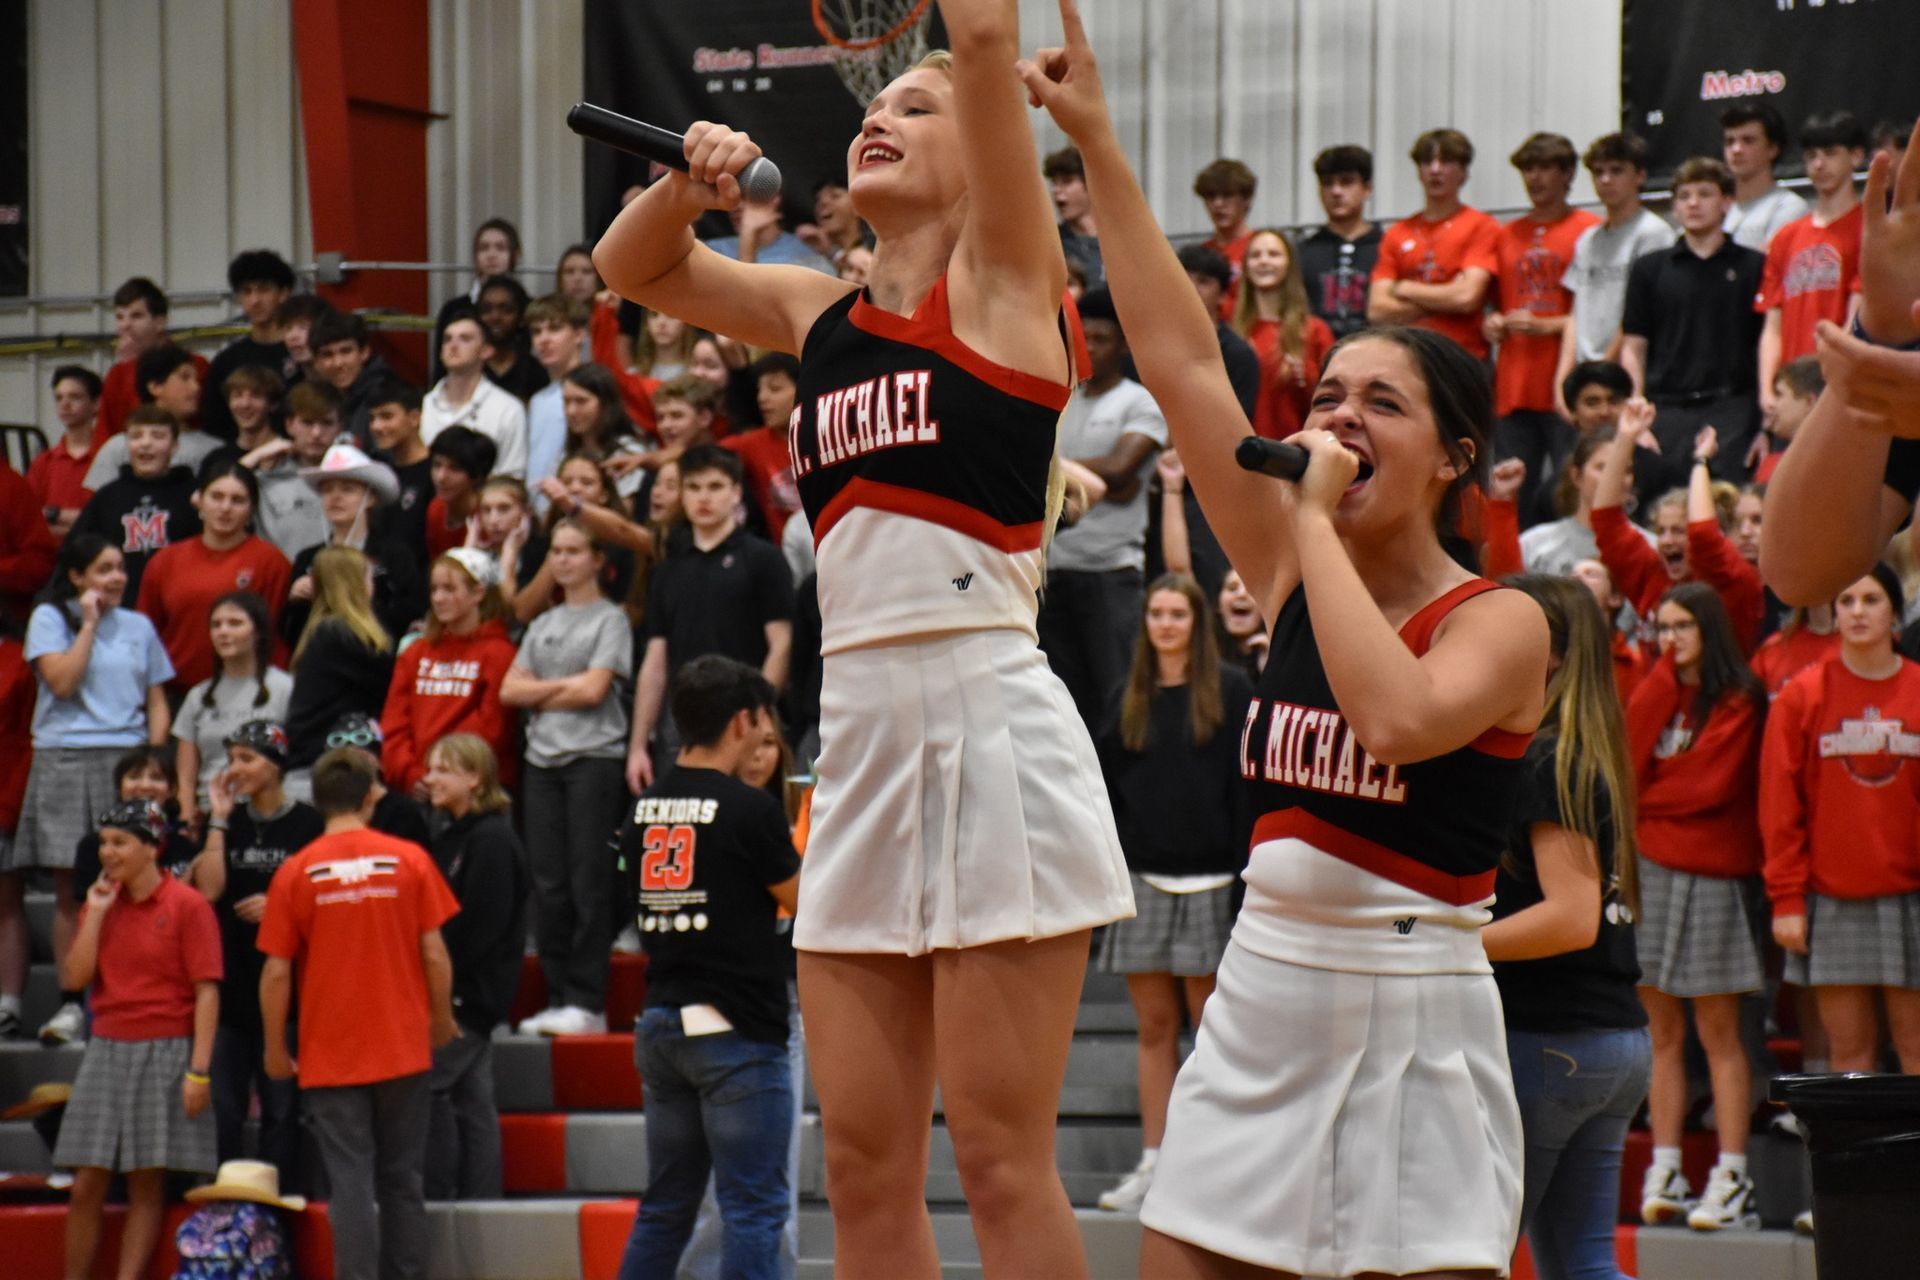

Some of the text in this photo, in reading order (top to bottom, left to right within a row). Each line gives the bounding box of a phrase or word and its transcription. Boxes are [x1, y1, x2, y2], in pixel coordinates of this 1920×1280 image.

[694, 47, 754, 73] State
[1701, 70, 1787, 100] Metro
[817, 370, 939, 468] MICHAEL
[634, 798, 719, 824] SENIORS
[640, 824, 696, 890] 23
